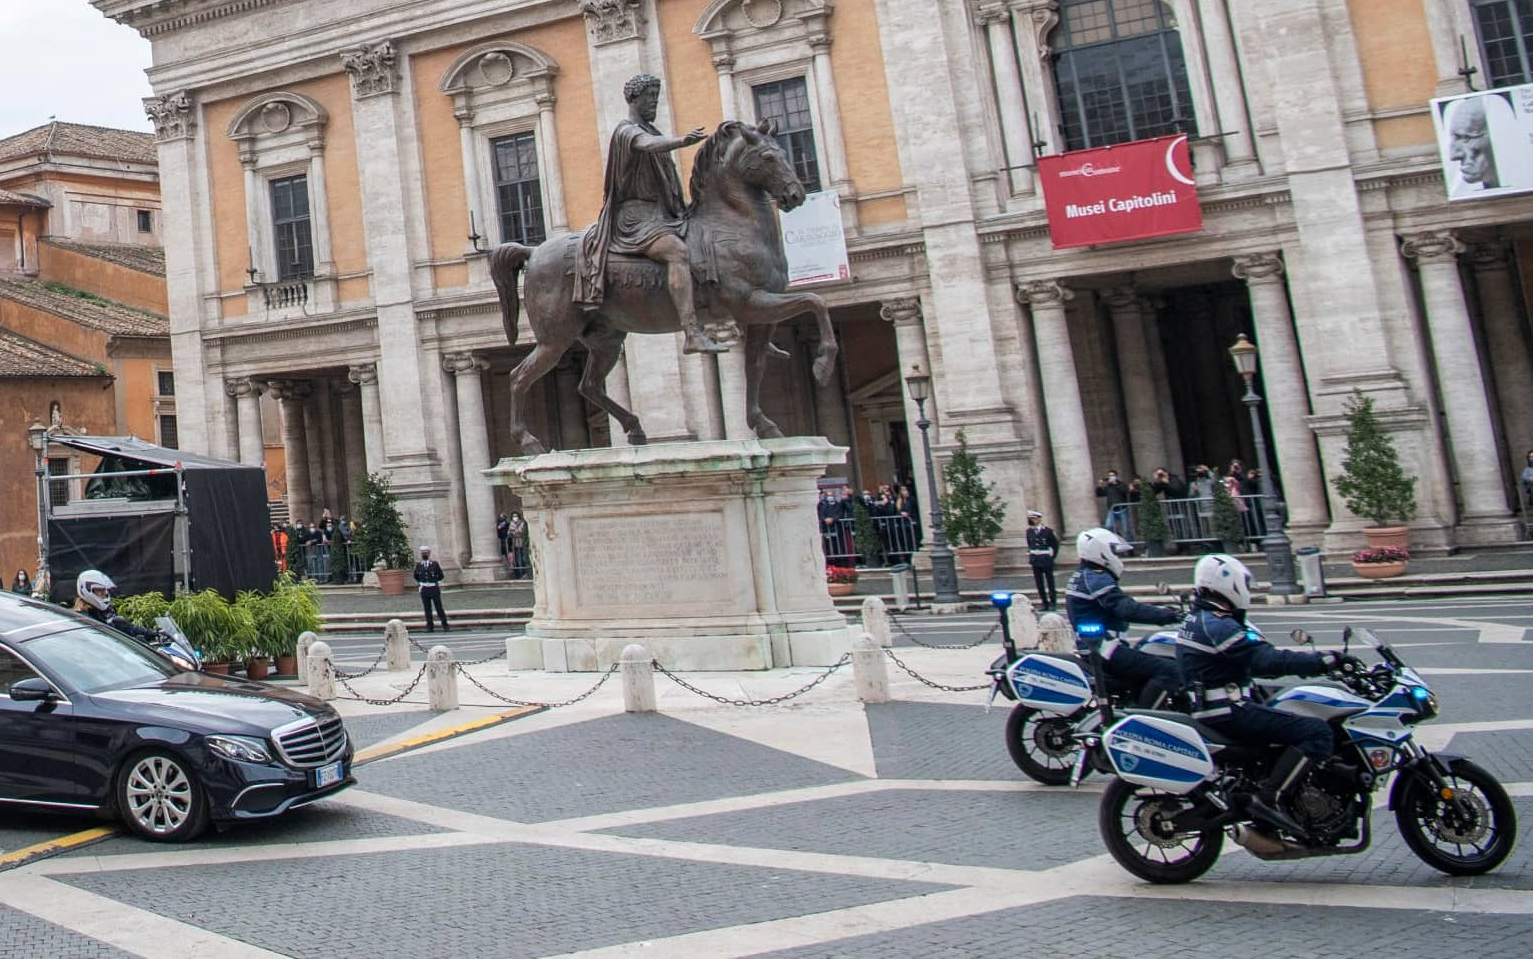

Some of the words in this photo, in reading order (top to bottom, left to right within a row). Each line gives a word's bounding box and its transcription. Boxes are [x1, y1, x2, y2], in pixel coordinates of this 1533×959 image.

[1066, 200, 1105, 218] Musei
[1108, 190, 1177, 212] Capitolini
[1115, 730, 1143, 741] POLIZIA
[1144, 736, 1166, 748] ROMA
[1167, 743, 1200, 758] CAPITALE
